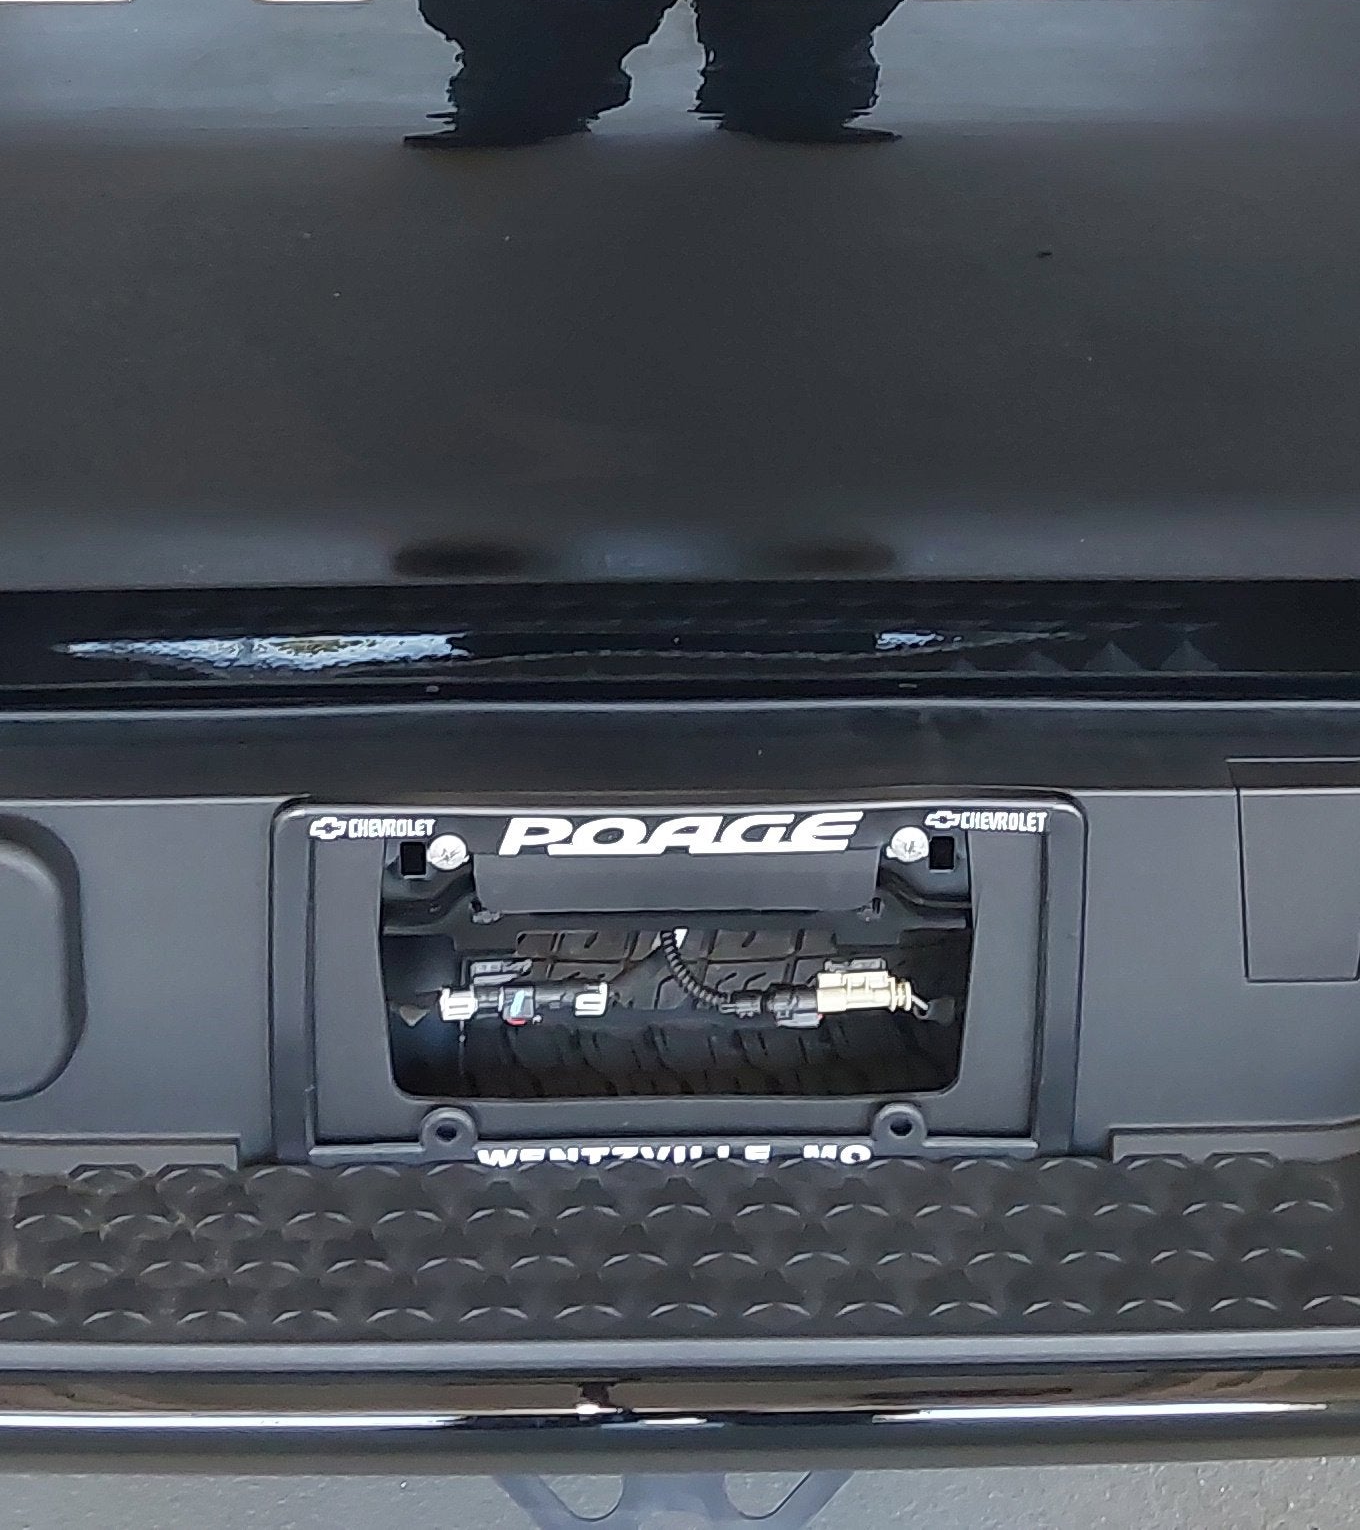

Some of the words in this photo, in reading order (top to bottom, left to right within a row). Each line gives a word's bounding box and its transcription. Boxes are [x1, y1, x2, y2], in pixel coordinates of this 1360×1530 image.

[348, 818, 436, 840] CHEVROLET
[960, 811, 1048, 833] CHEVROLET
[498, 811, 864, 857] POAGE
